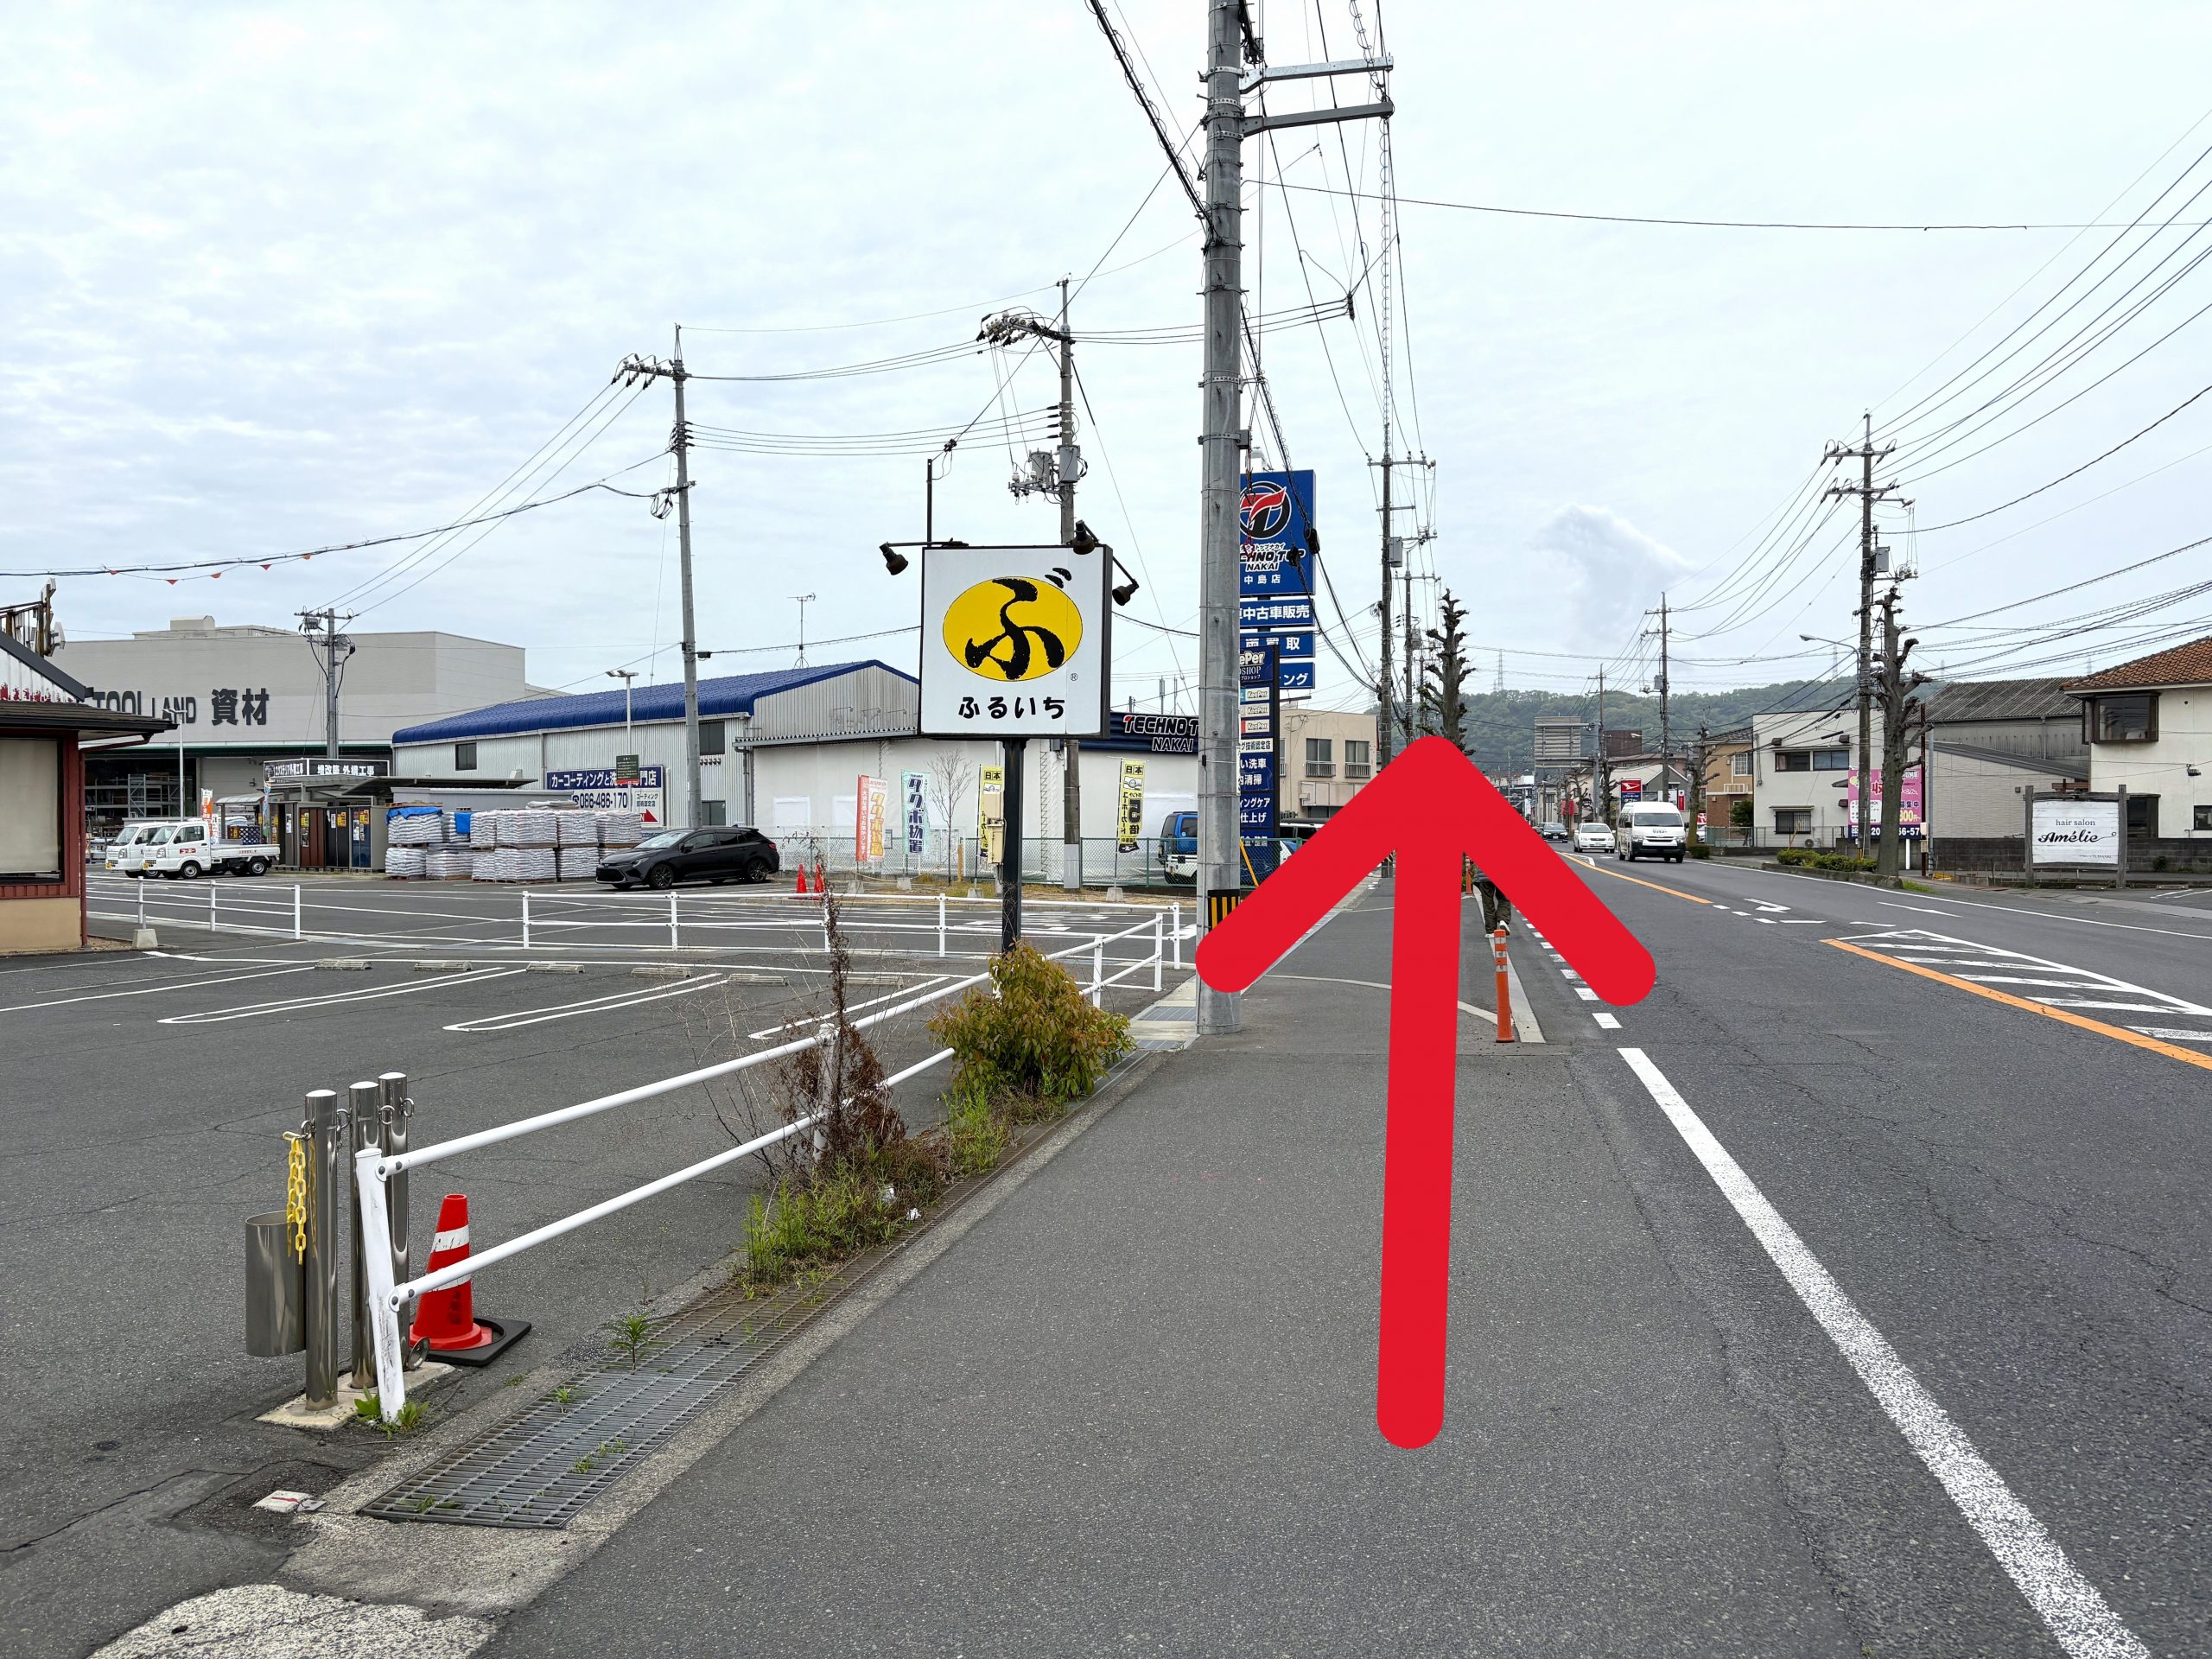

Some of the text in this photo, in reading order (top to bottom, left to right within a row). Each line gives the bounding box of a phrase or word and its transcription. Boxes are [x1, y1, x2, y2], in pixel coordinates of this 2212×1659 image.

[1246, 562, 1280, 571] NAKAI
[1244, 574, 1281, 584] 中島店
[1240, 605, 1310, 620] 中古車販売
[1240, 666, 1262, 675] SHOP
[1280, 672, 1308, 686] ング
[1248, 690, 1268, 699] KeePer
[212, 689, 270, 726] 資材
[958, 696, 1065, 719] ふるいち
[1248, 705, 1268, 715] KeePer
[1123, 715, 1188, 735] TECHNO
[1248, 721, 1268, 731] KeePer
[1152, 737, 1194, 752] NAKAI
[342, 765, 375, 777] 外構工事
[551, 769, 657, 788] カーコーティングと洗門店
[580, 792, 632, 809] 086-486-170
[908, 779, 924, 853] タクボ物置
[1241, 812, 1267, 823] 仕上げ
[2038, 830, 2116, 843] Amélie
